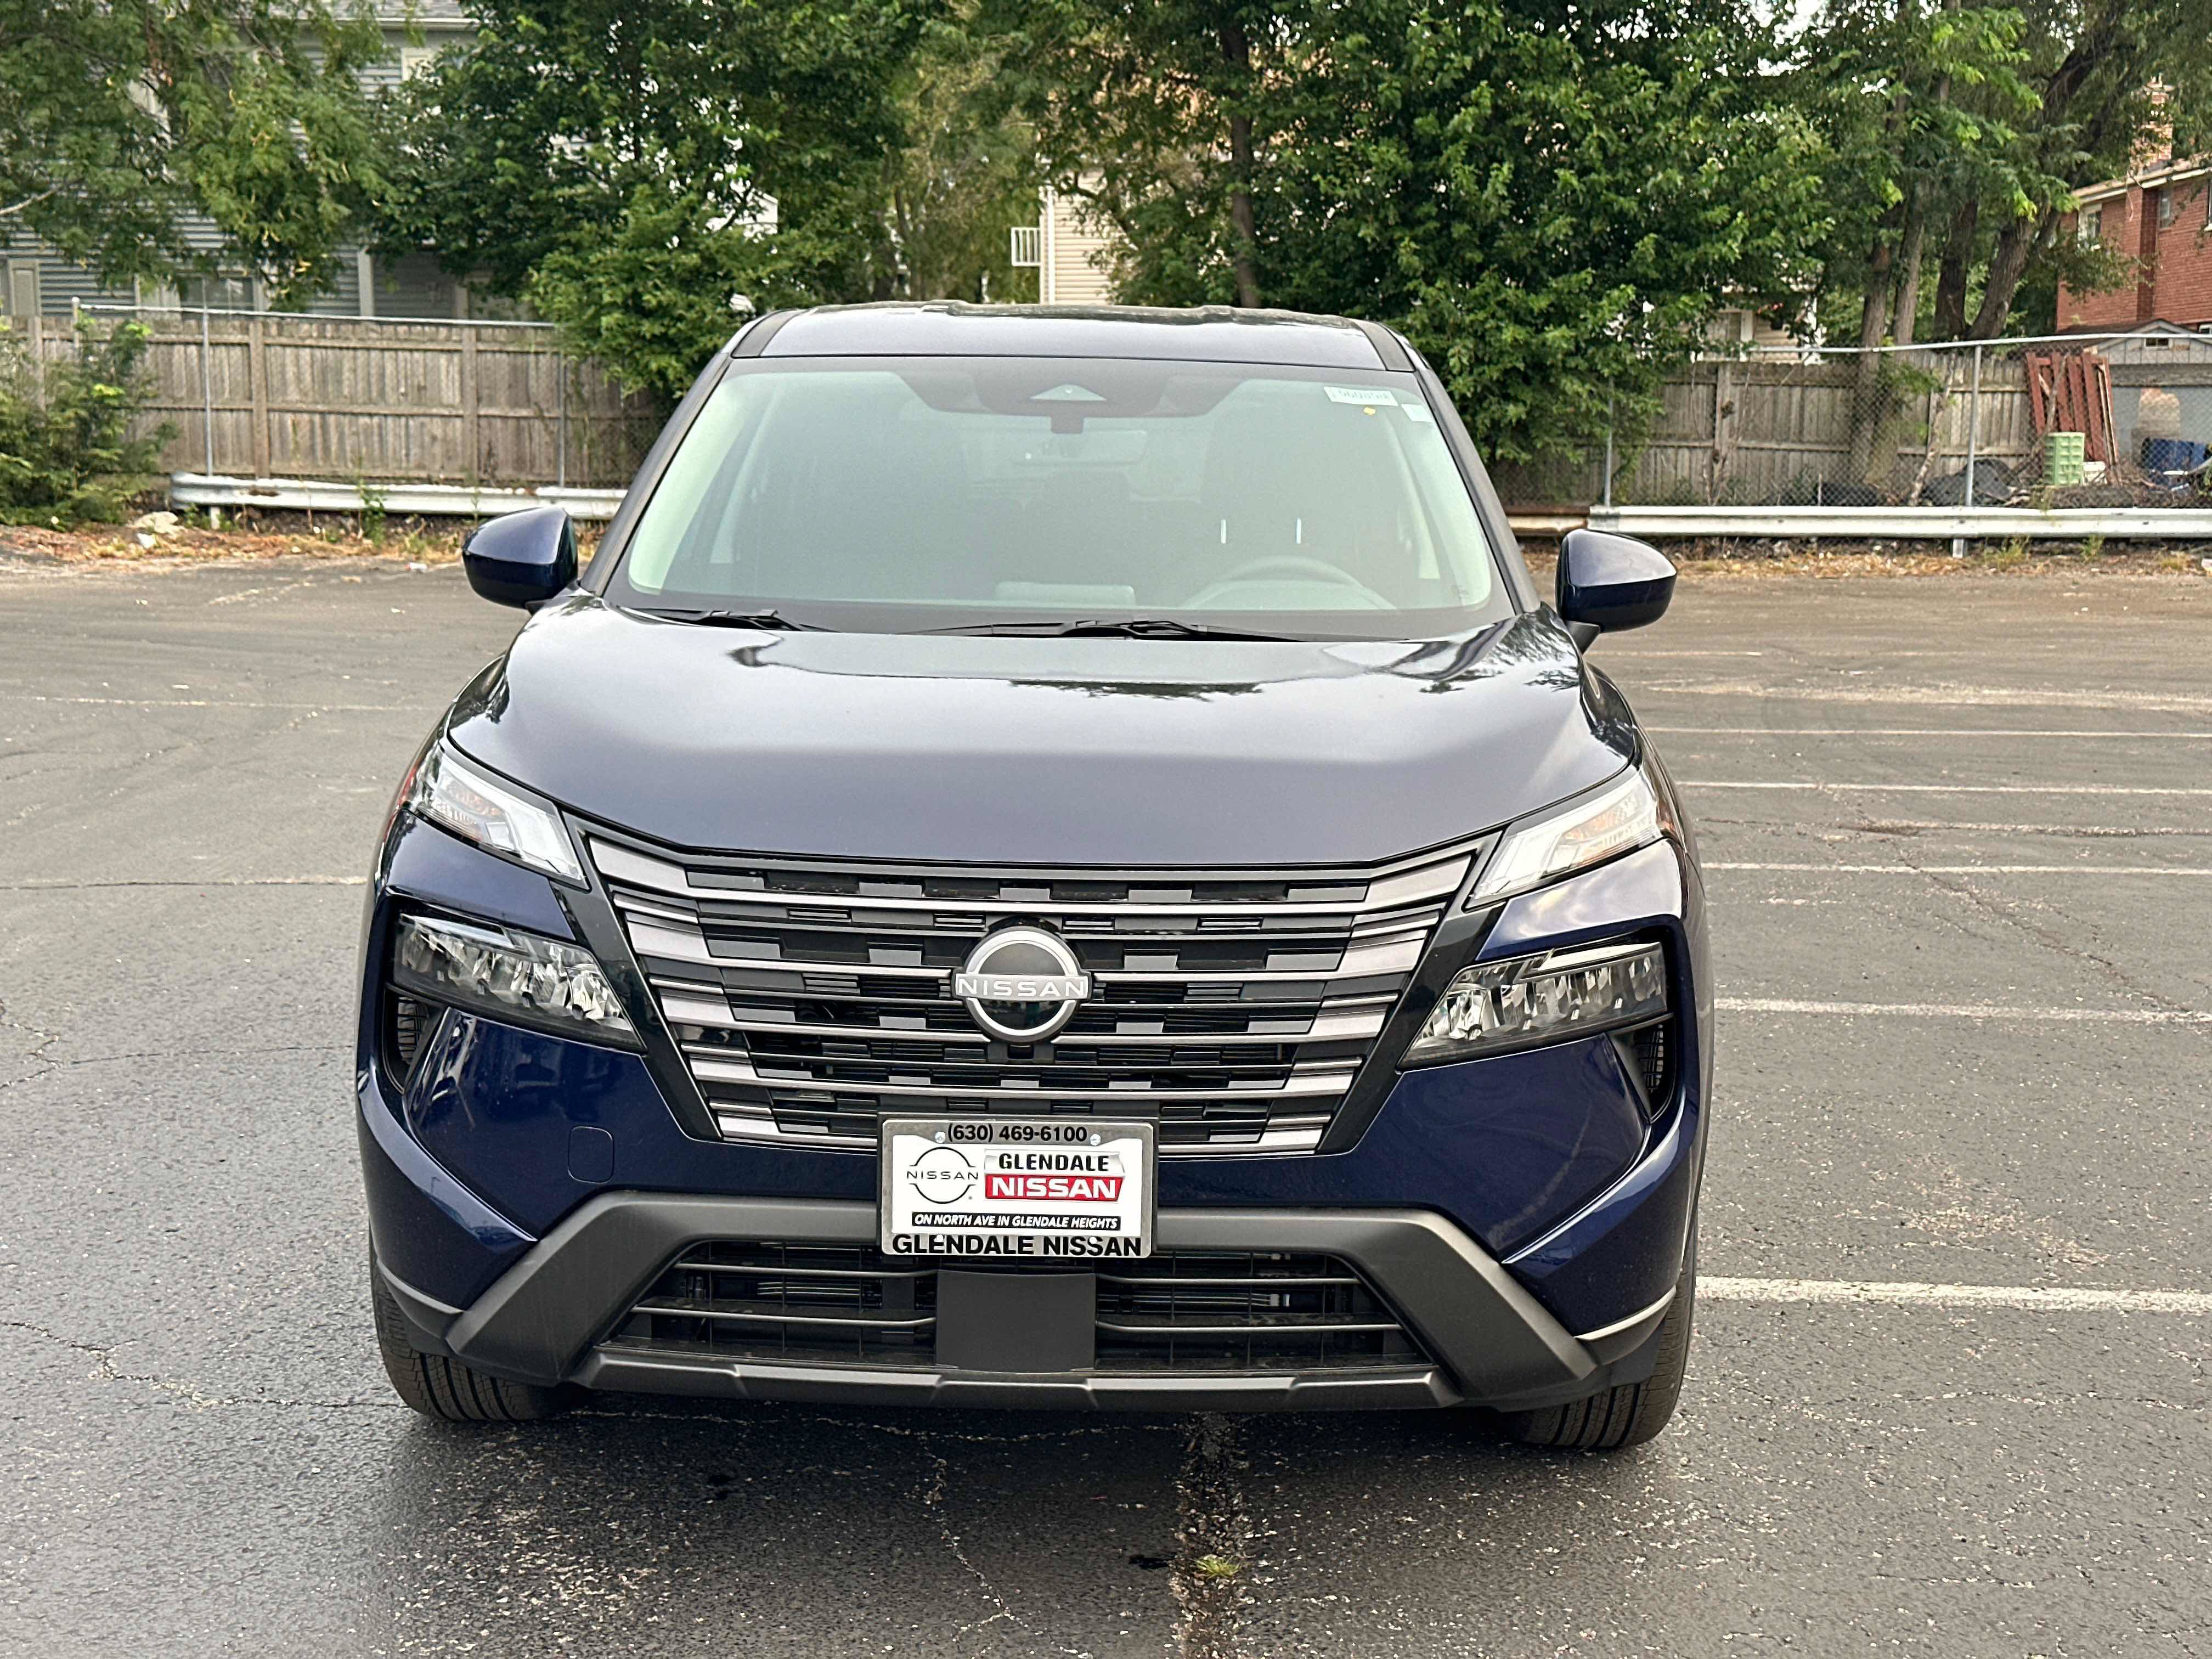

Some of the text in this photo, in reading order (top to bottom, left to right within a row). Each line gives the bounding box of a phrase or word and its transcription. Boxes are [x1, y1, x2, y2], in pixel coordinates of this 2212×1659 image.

[958, 978, 1085, 996] NISSAN
[948, 1124, 1087, 1142] (630) 469-6100
[999, 1153, 1109, 1172] GLENDALE
[907, 1170, 978, 1181] NISSAN
[991, 1177, 1116, 1199] NISSAN
[915, 1214, 1118, 1229] ON NORTH AVE IN GLENDALE HEIGHTS
[892, 1234, 1141, 1256] GLENDALE NISSAN
